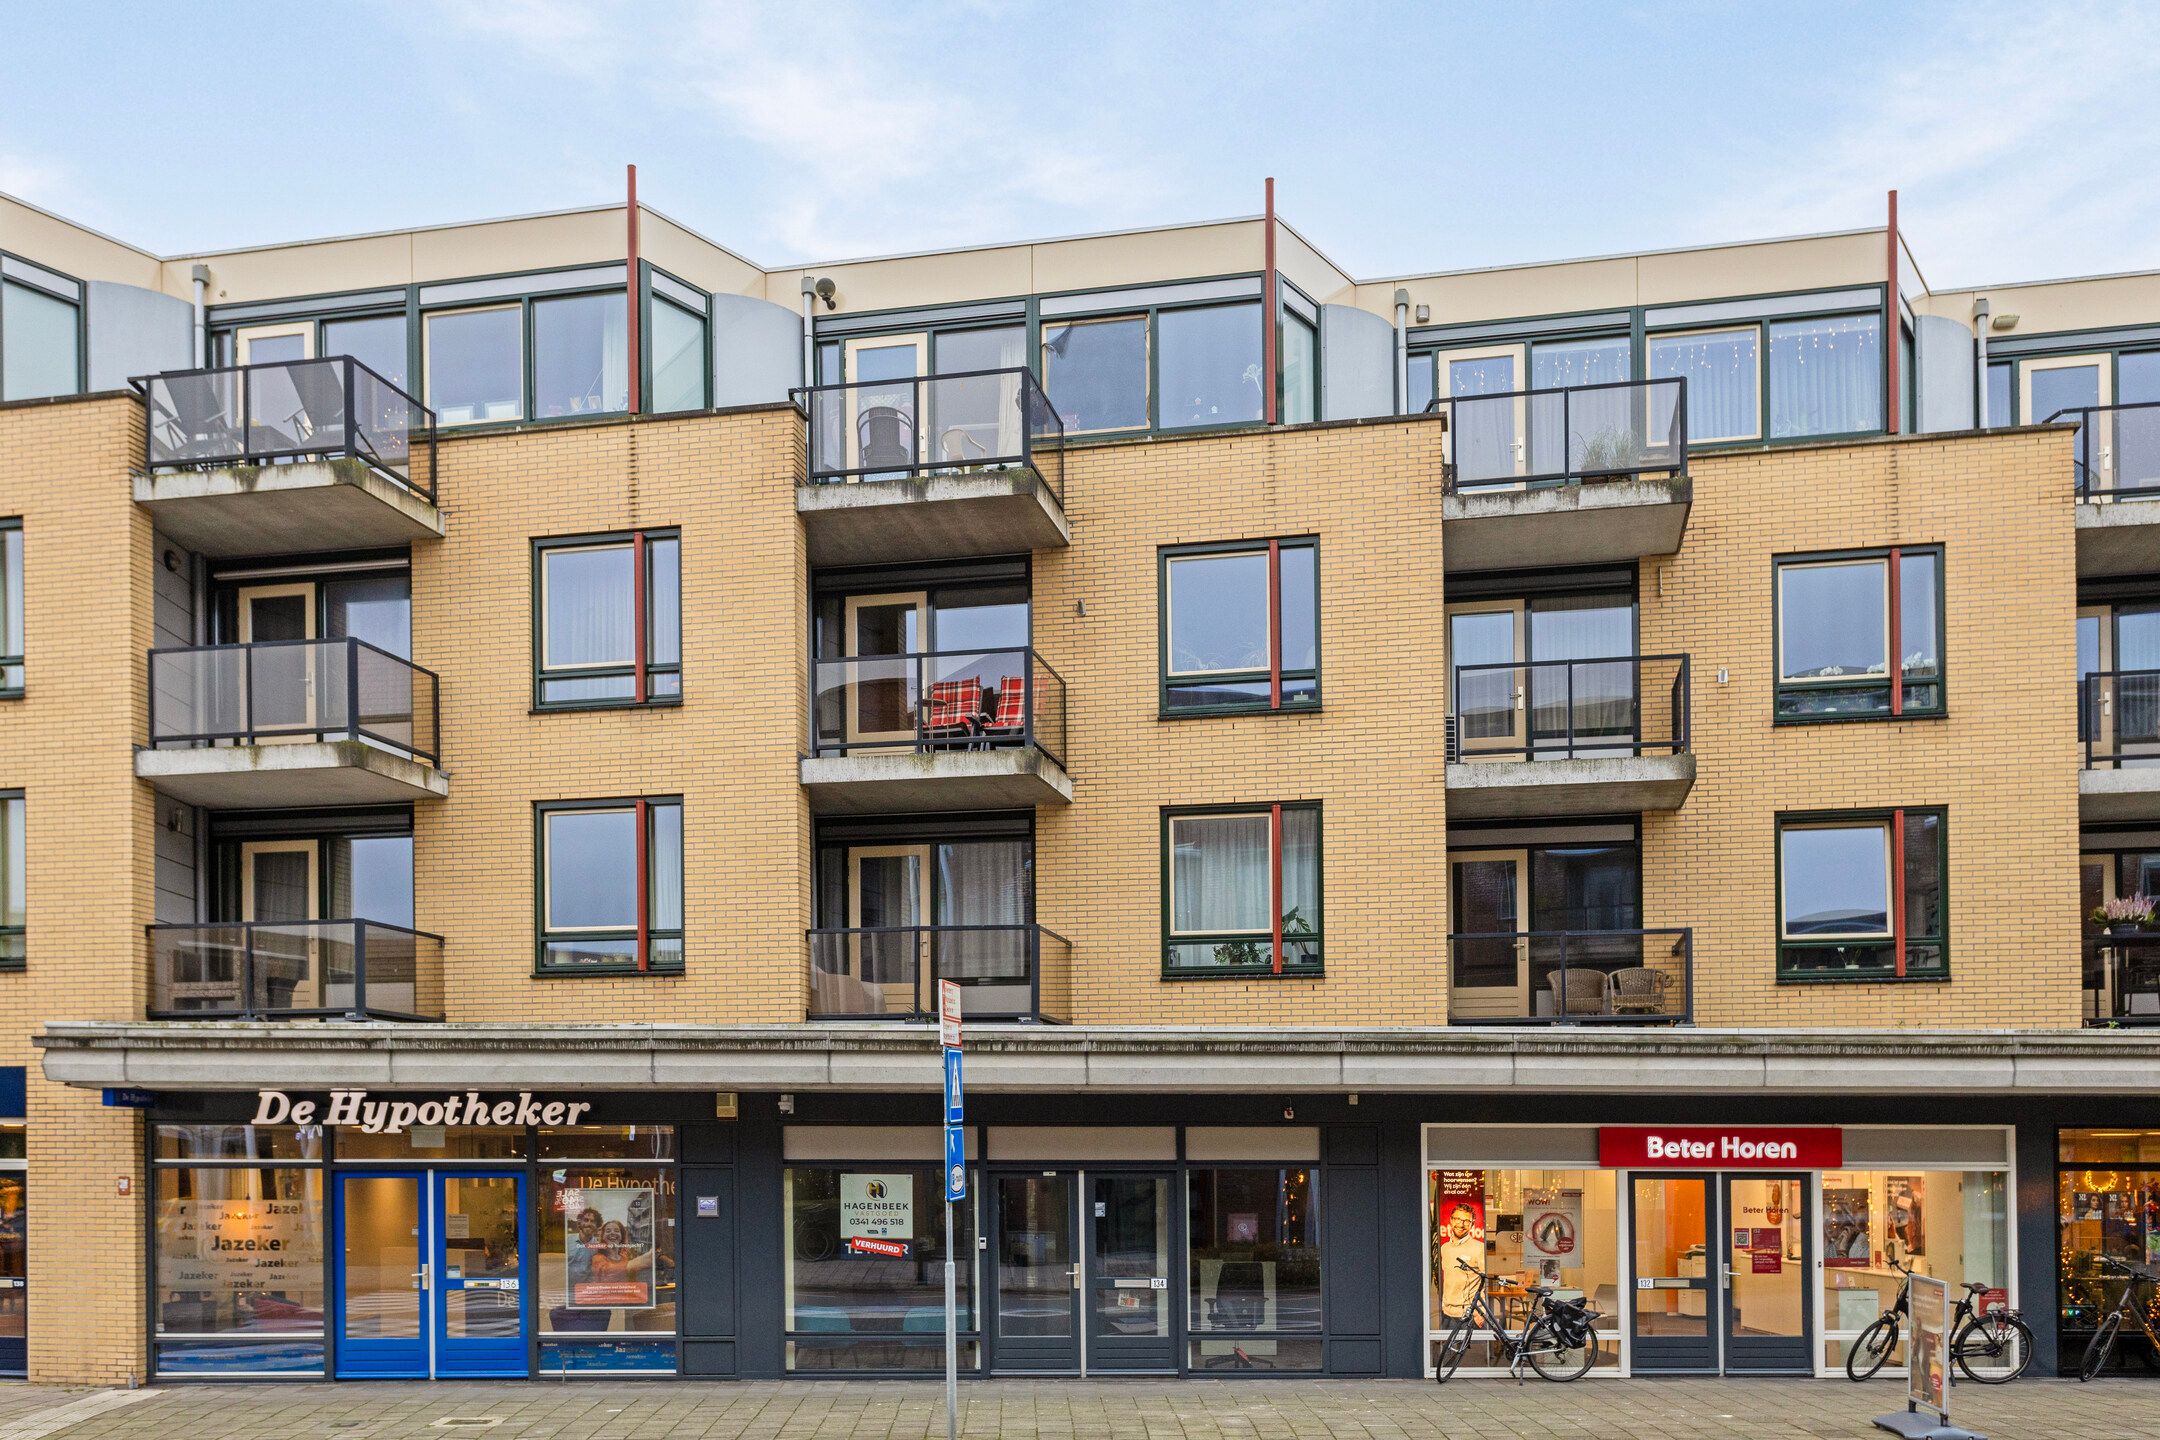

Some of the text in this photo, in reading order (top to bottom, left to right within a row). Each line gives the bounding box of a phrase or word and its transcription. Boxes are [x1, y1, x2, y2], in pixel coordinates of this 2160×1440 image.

[251, 1091, 590, 1134] De Hypotheker
[1647, 1135, 1798, 1159] Beter Horen
[844, 1202, 909, 1210] HAGENBEEK
[1743, 1206, 1790, 1214] Beter Horen
[182, 1222, 222, 1231] Jaker
[849, 1218, 904, 1226] 0341 496 518
[211, 1235, 290, 1251] Jazeker
[855, 1239, 900, 1254] VERHUURD
[255, 1258, 299, 1268] Jazeker
[223, 1279, 266, 1288] azeker
[502, 1280, 517, 1289] 136
[1153, 1280, 1165, 1288] 134
[1640, 1280, 1651, 1288] 132
